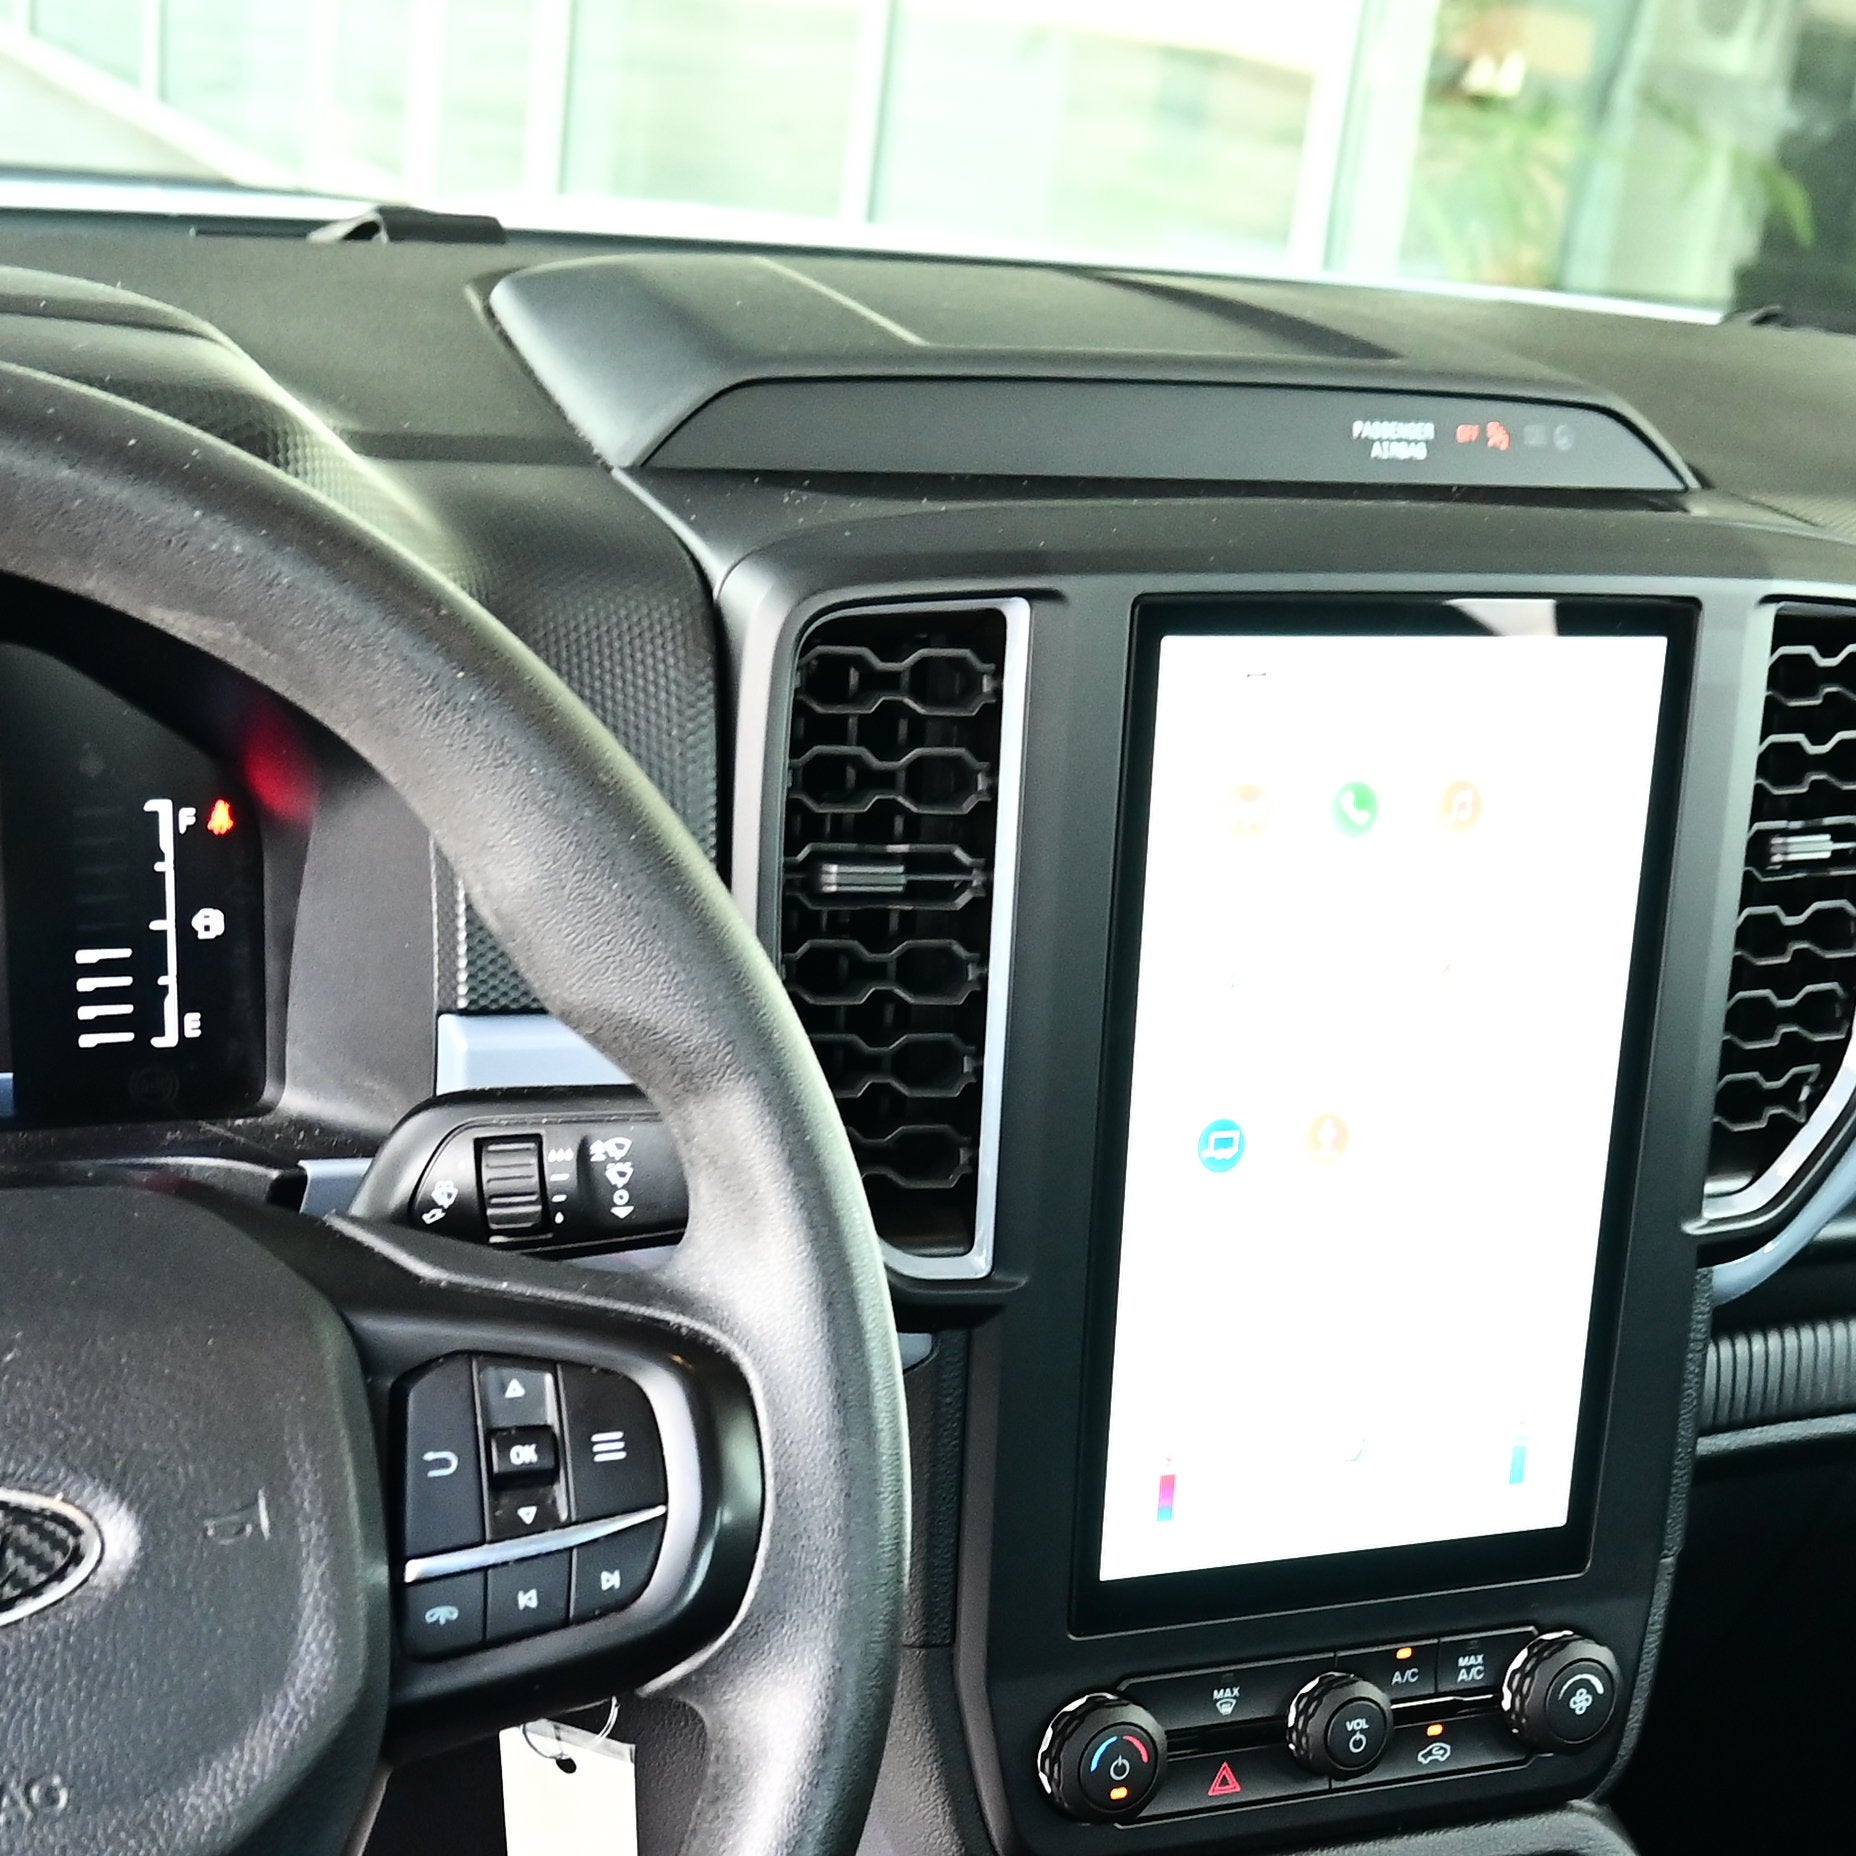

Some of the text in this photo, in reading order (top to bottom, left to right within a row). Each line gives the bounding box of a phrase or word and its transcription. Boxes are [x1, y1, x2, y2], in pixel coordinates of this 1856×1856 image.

[178, 807, 197, 835] F
[183, 1012, 202, 1038] E
[508, 1443, 539, 1467] OK
[1457, 1654, 1485, 1667] MAX
[1391, 1667, 1420, 1686] A/C
[1456, 1666, 1485, 1683] A/C
[1212, 1686, 1240, 1700] MAX
[1345, 1718, 1370, 1731] VOL
